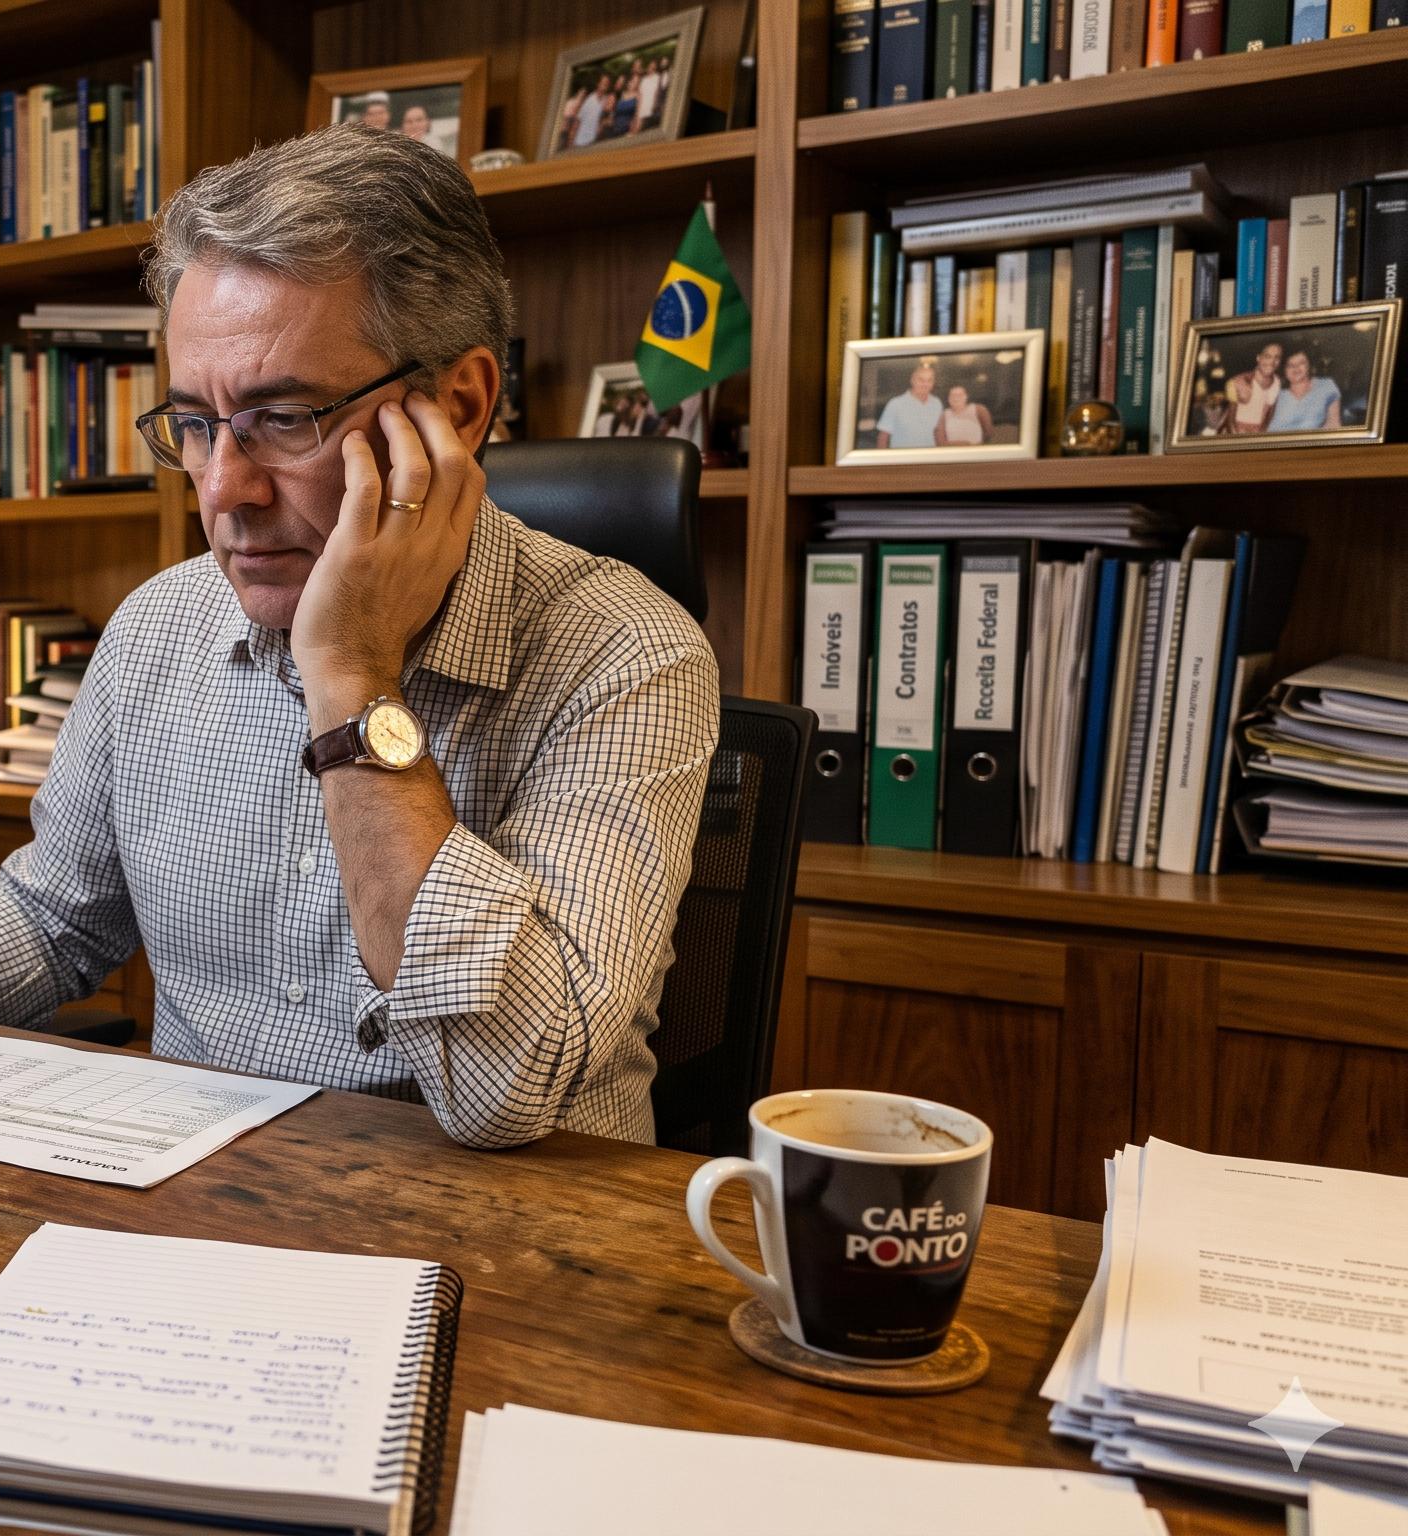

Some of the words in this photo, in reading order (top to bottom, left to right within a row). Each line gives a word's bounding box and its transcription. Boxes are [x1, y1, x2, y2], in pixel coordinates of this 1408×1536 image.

[977, 582, 999, 649] Federal
[821, 612, 842, 689] Imóveis
[895, 600, 919, 699] Contratos
[846, 1231, 968, 1267] PONTO
[861, 1200, 944, 1232] CAFÉ
[945, 1212, 967, 1229] DO
